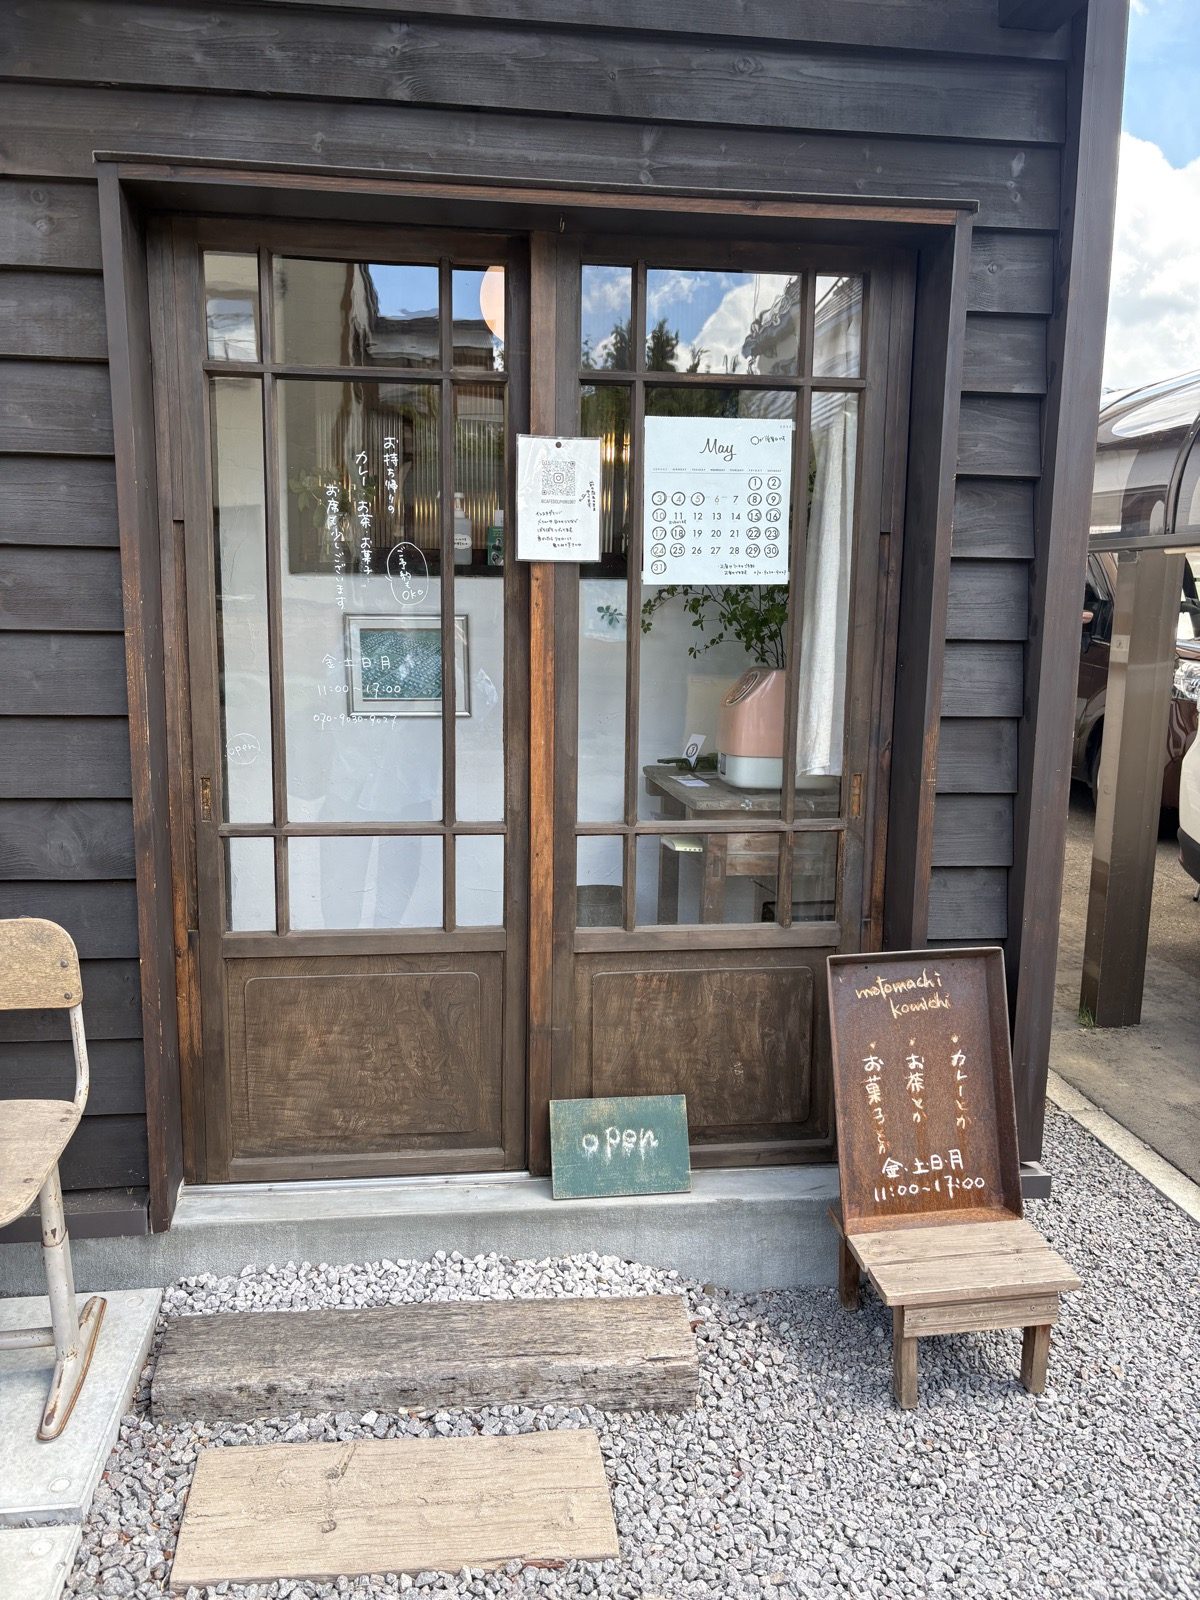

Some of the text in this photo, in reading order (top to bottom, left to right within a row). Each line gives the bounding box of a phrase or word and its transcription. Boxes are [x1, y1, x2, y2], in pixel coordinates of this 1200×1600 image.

[700, 438, 736, 461] May
[383, 436, 399, 514] お持ち帰りの
[771, 479, 777, 487] 2
[715, 495, 719, 503] 6
[733, 495, 739, 503] 7
[752, 495, 757, 503] 8
[771, 495, 776, 504] 9
[656, 512, 778, 521] 10 11 12 13 14 15 16
[656, 529, 777, 538] 17 18 19 20 21 22 23
[673, 546, 683, 555] 25
[691, 547, 702, 555] 26
[710, 546, 721, 555] 27
[729, 546, 740, 555] 28
[748, 547, 758, 555] 29
[766, 547, 777, 555] 30
[654, 563, 663, 571] 31
[229, 744, 256, 757] open
[855, 968, 942, 999] motomachi
[905, 1053, 928, 1123] お茶とか
[950, 1049, 972, 1129] カレーとか
[582, 1126, 659, 1161] open
